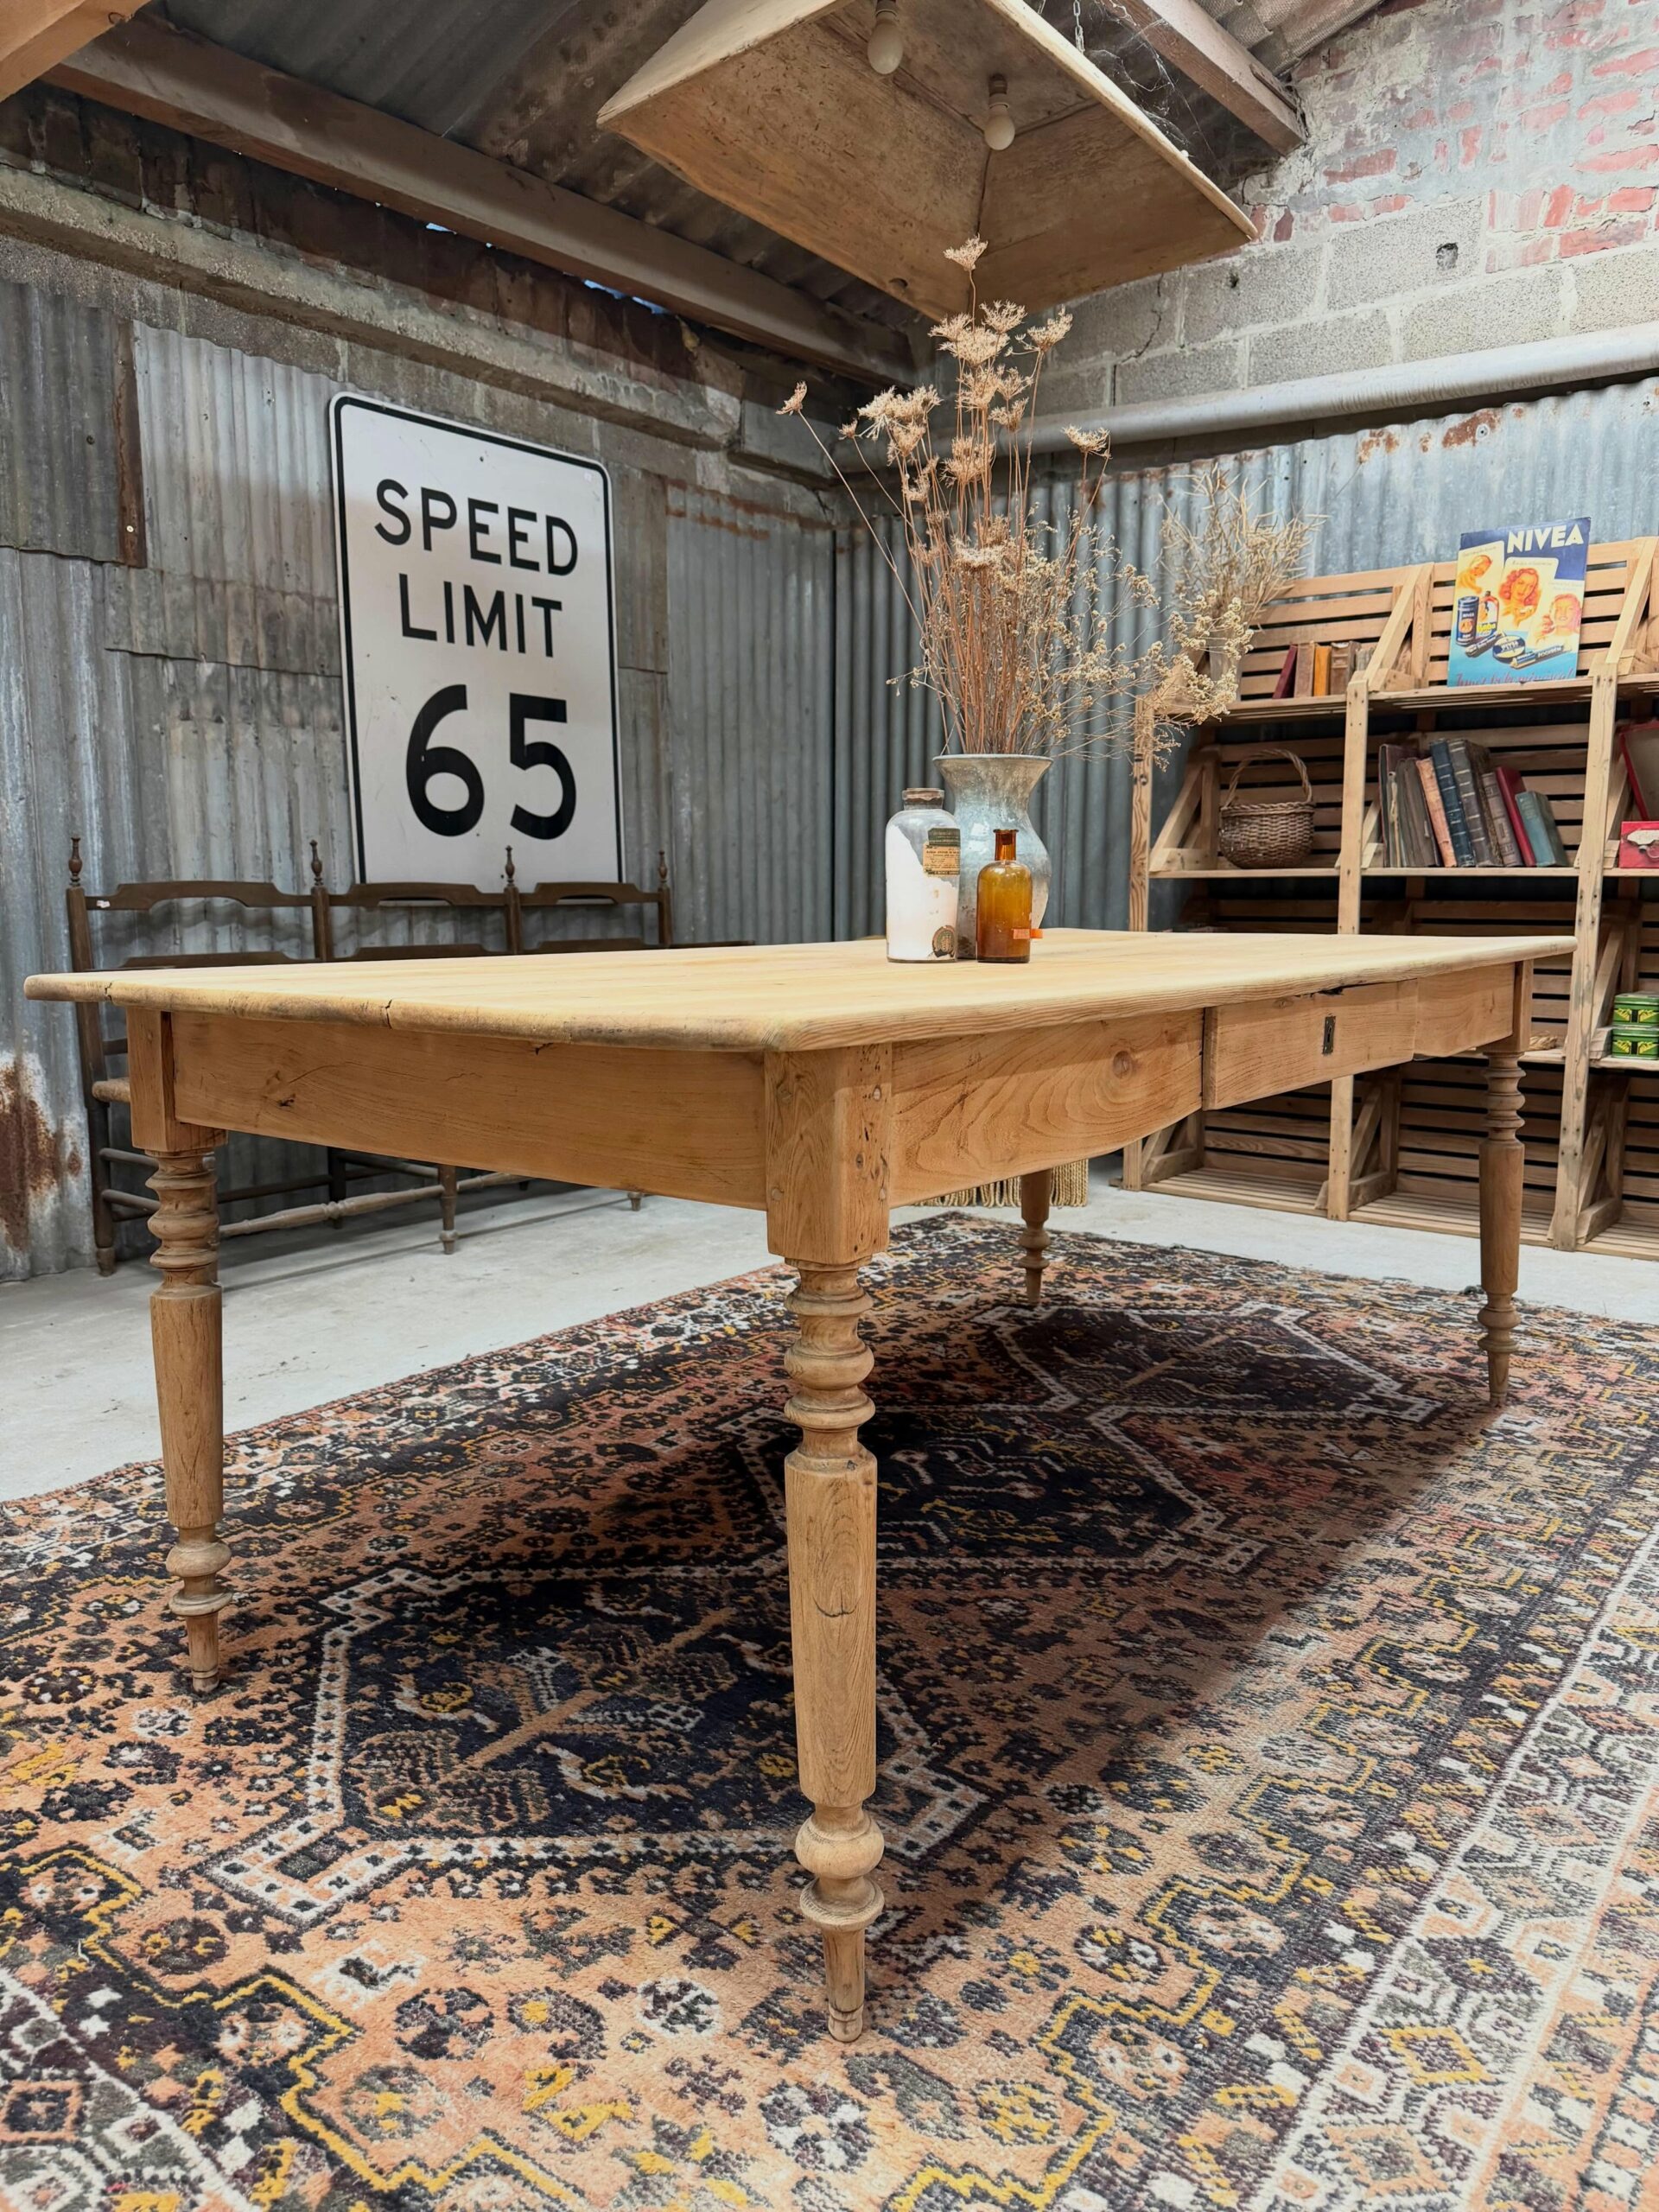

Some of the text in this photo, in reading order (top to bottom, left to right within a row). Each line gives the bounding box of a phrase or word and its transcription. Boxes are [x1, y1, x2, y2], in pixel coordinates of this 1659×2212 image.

[374, 478, 578, 576] SPEED
[1507, 524, 1584, 554] NIVEA
[398, 573, 563, 658] LIMIT
[405, 683, 577, 840] 65
